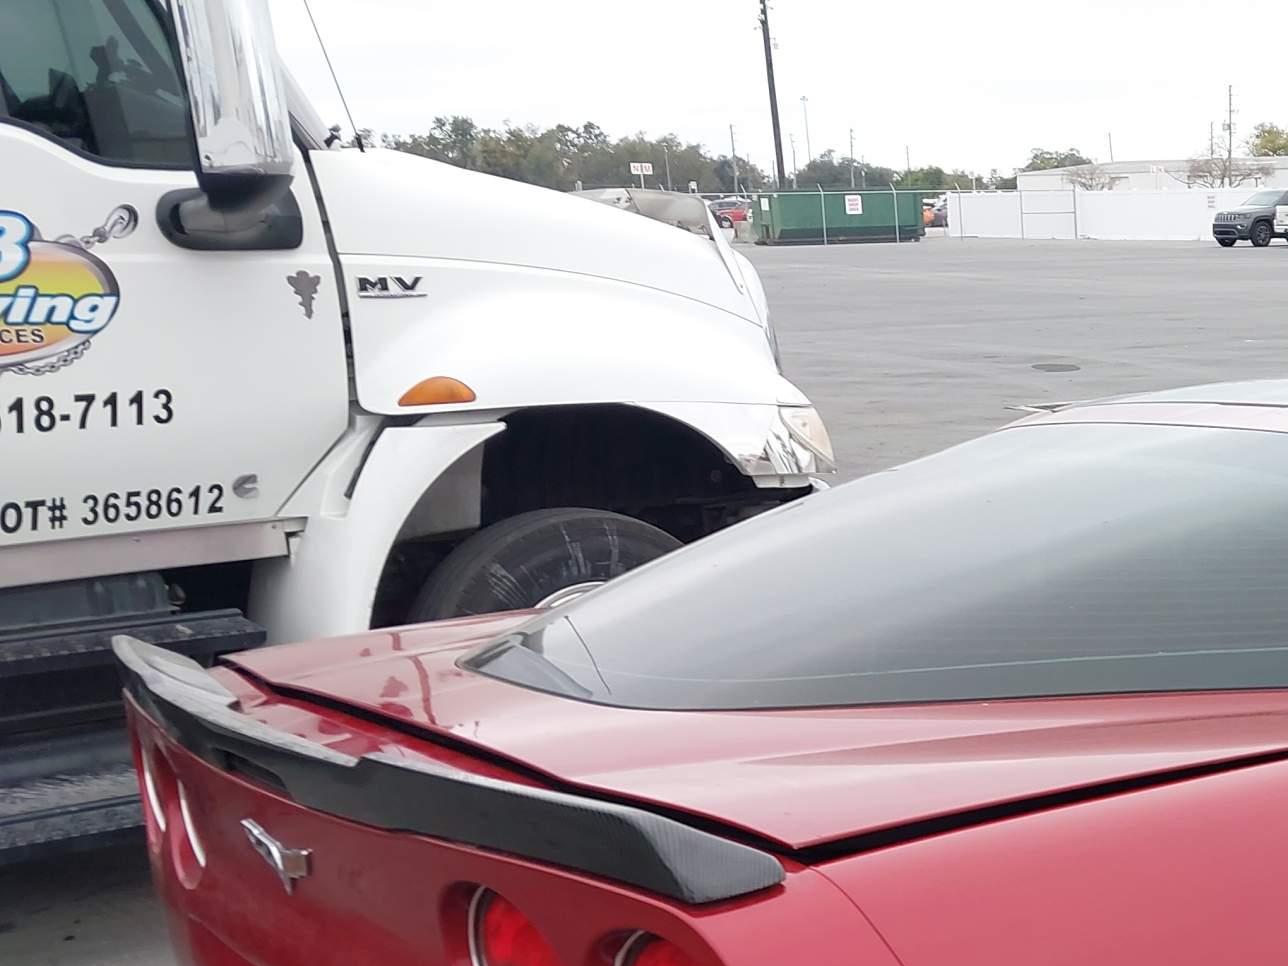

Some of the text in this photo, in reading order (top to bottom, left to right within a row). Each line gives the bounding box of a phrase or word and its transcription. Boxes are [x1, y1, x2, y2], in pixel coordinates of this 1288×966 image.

[357, 276, 423, 292] MV
[0, 389, 173, 434] 18-7113
[81, 483, 226, 528] 3658612
